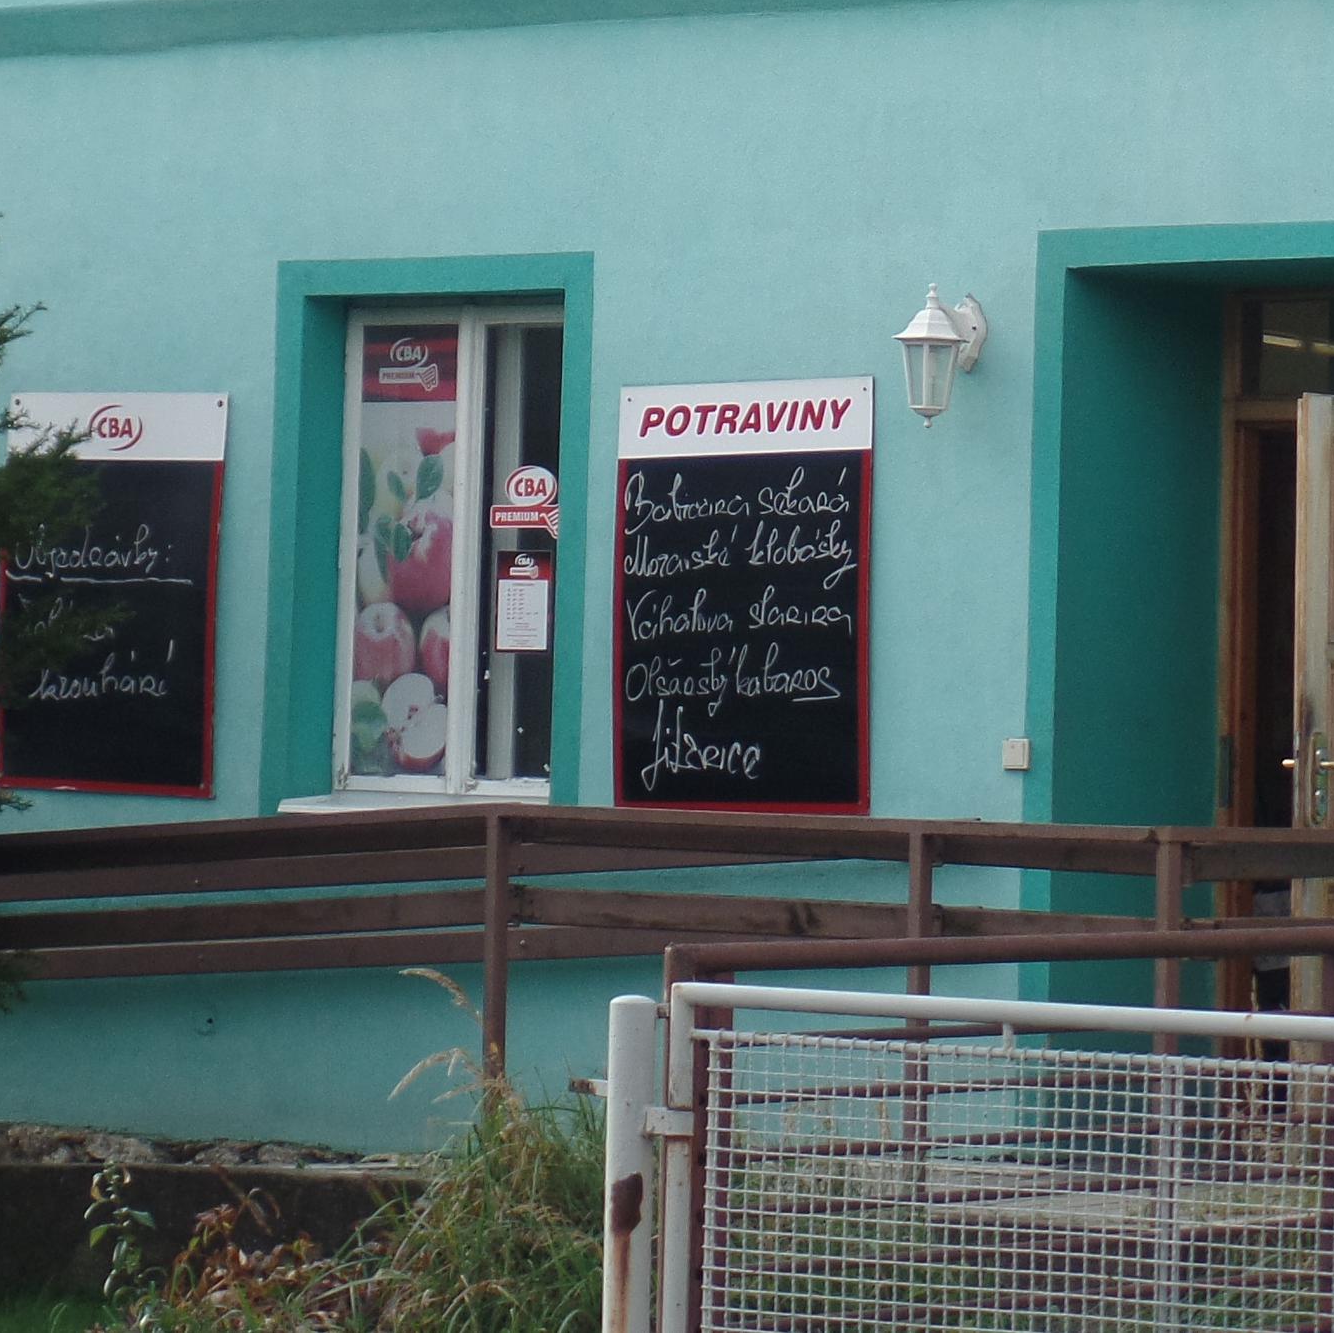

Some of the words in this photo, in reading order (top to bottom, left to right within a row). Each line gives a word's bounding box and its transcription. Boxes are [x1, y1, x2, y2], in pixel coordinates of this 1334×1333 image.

[395, 345, 423, 361] CBA
[97, 416, 134, 439] CBA
[638, 398, 852, 438] POTRAVINY
[514, 477, 548, 497] CBA
[494, 511, 540, 522] PREMIUM
[748, 584, 852, 635] slanina
[736, 641, 842, 703] kabanos
